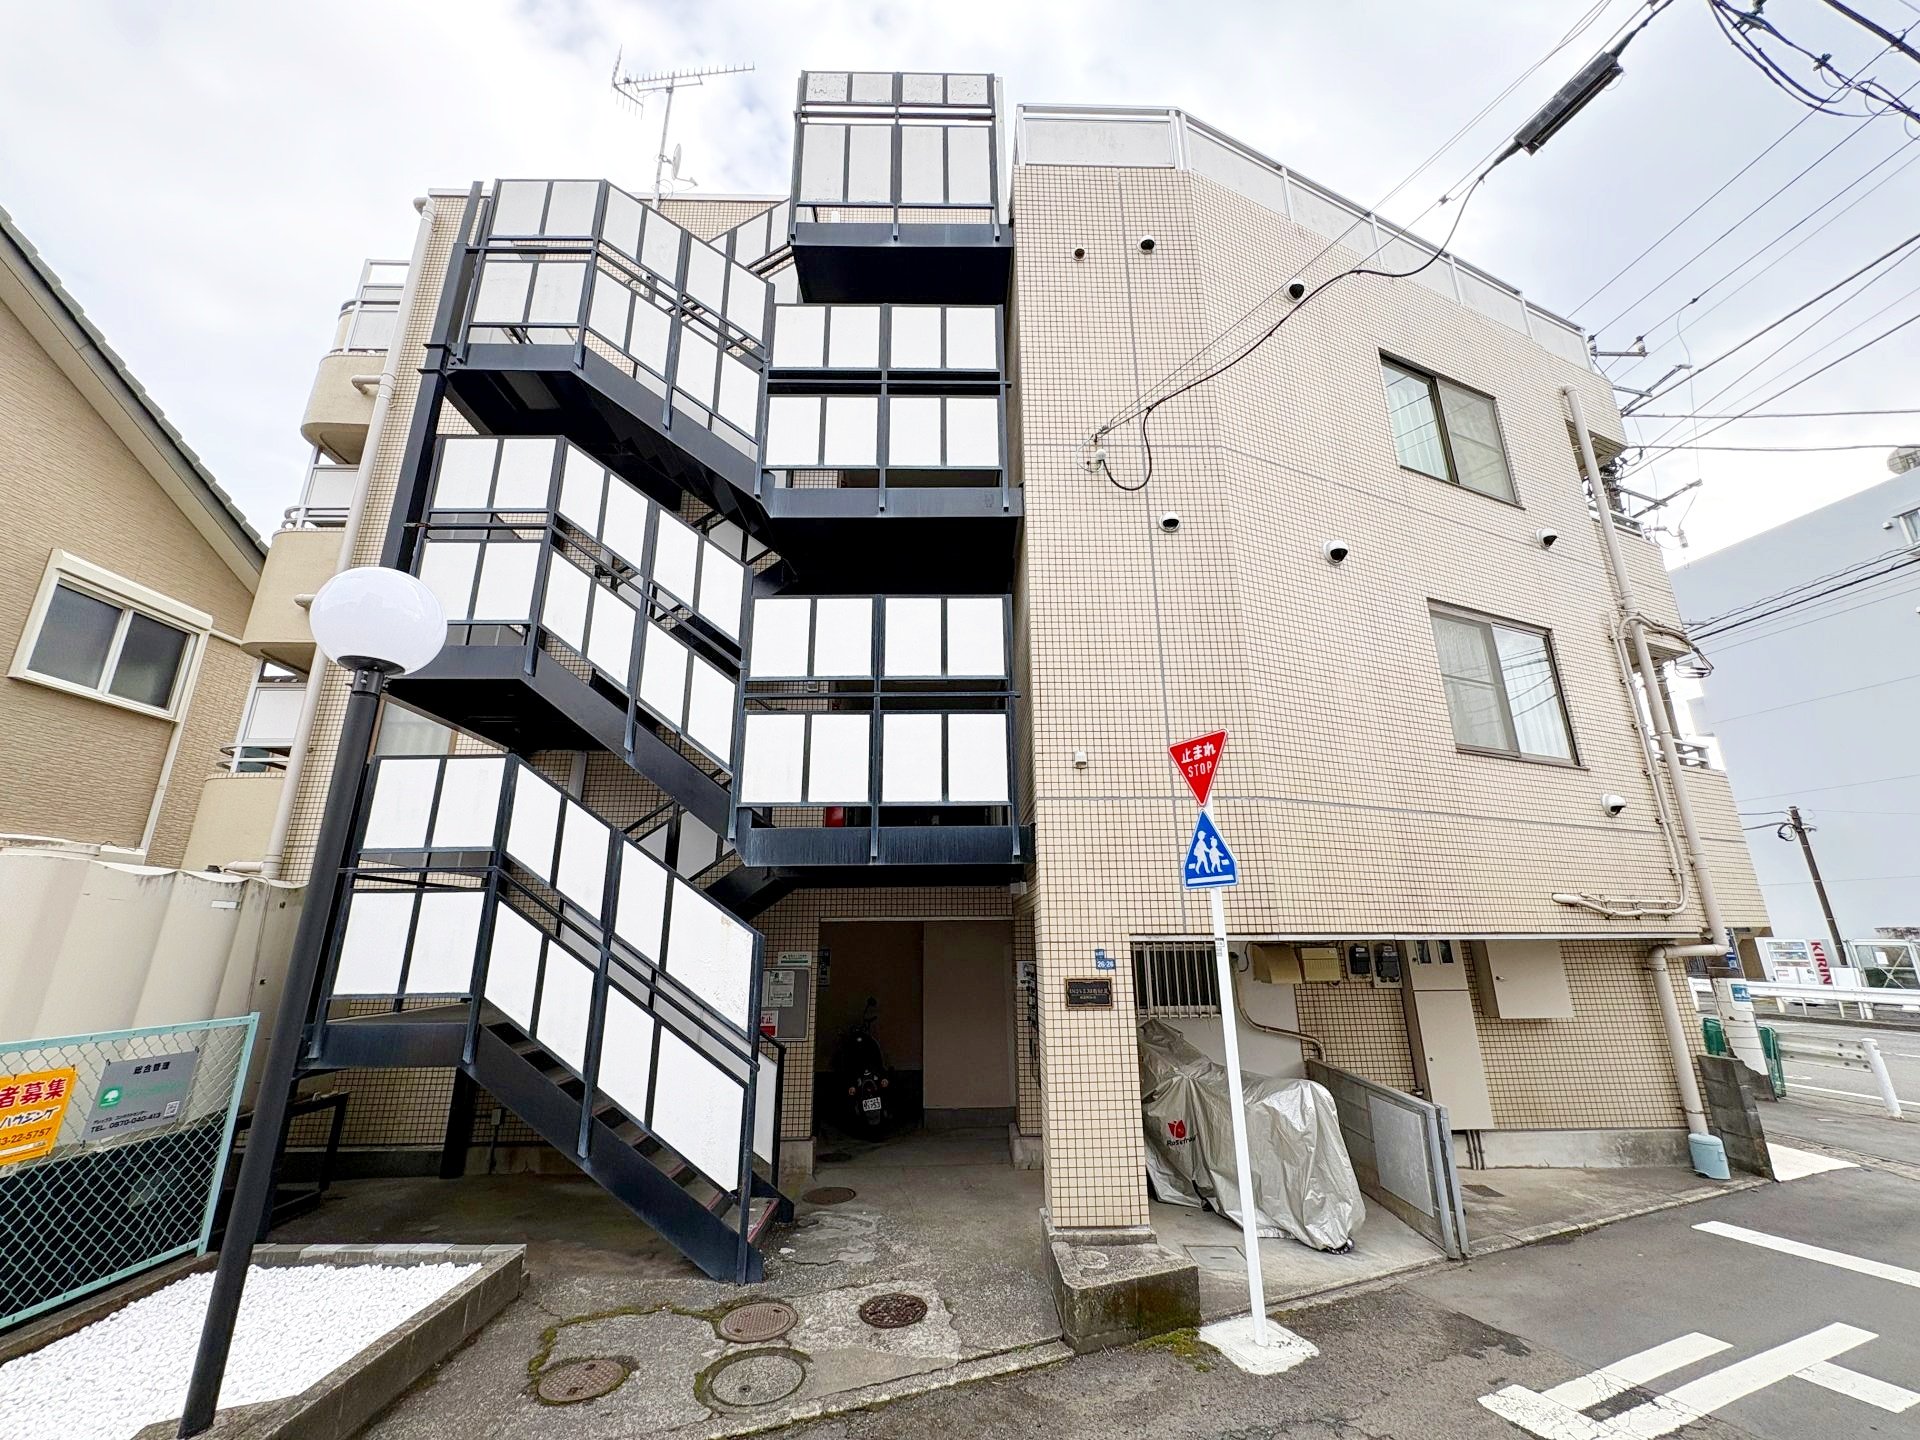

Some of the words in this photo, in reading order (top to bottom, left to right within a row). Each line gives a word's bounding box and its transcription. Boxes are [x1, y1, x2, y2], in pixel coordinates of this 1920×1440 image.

[1181, 741, 1216, 764] 止まれ
[1187, 761, 1213, 778] STOP
[1810, 941, 1833, 985] KIRIN
[0, 1078, 66, 1108] 者募集
[0, 1127, 52, 1146] 3-22-5757
